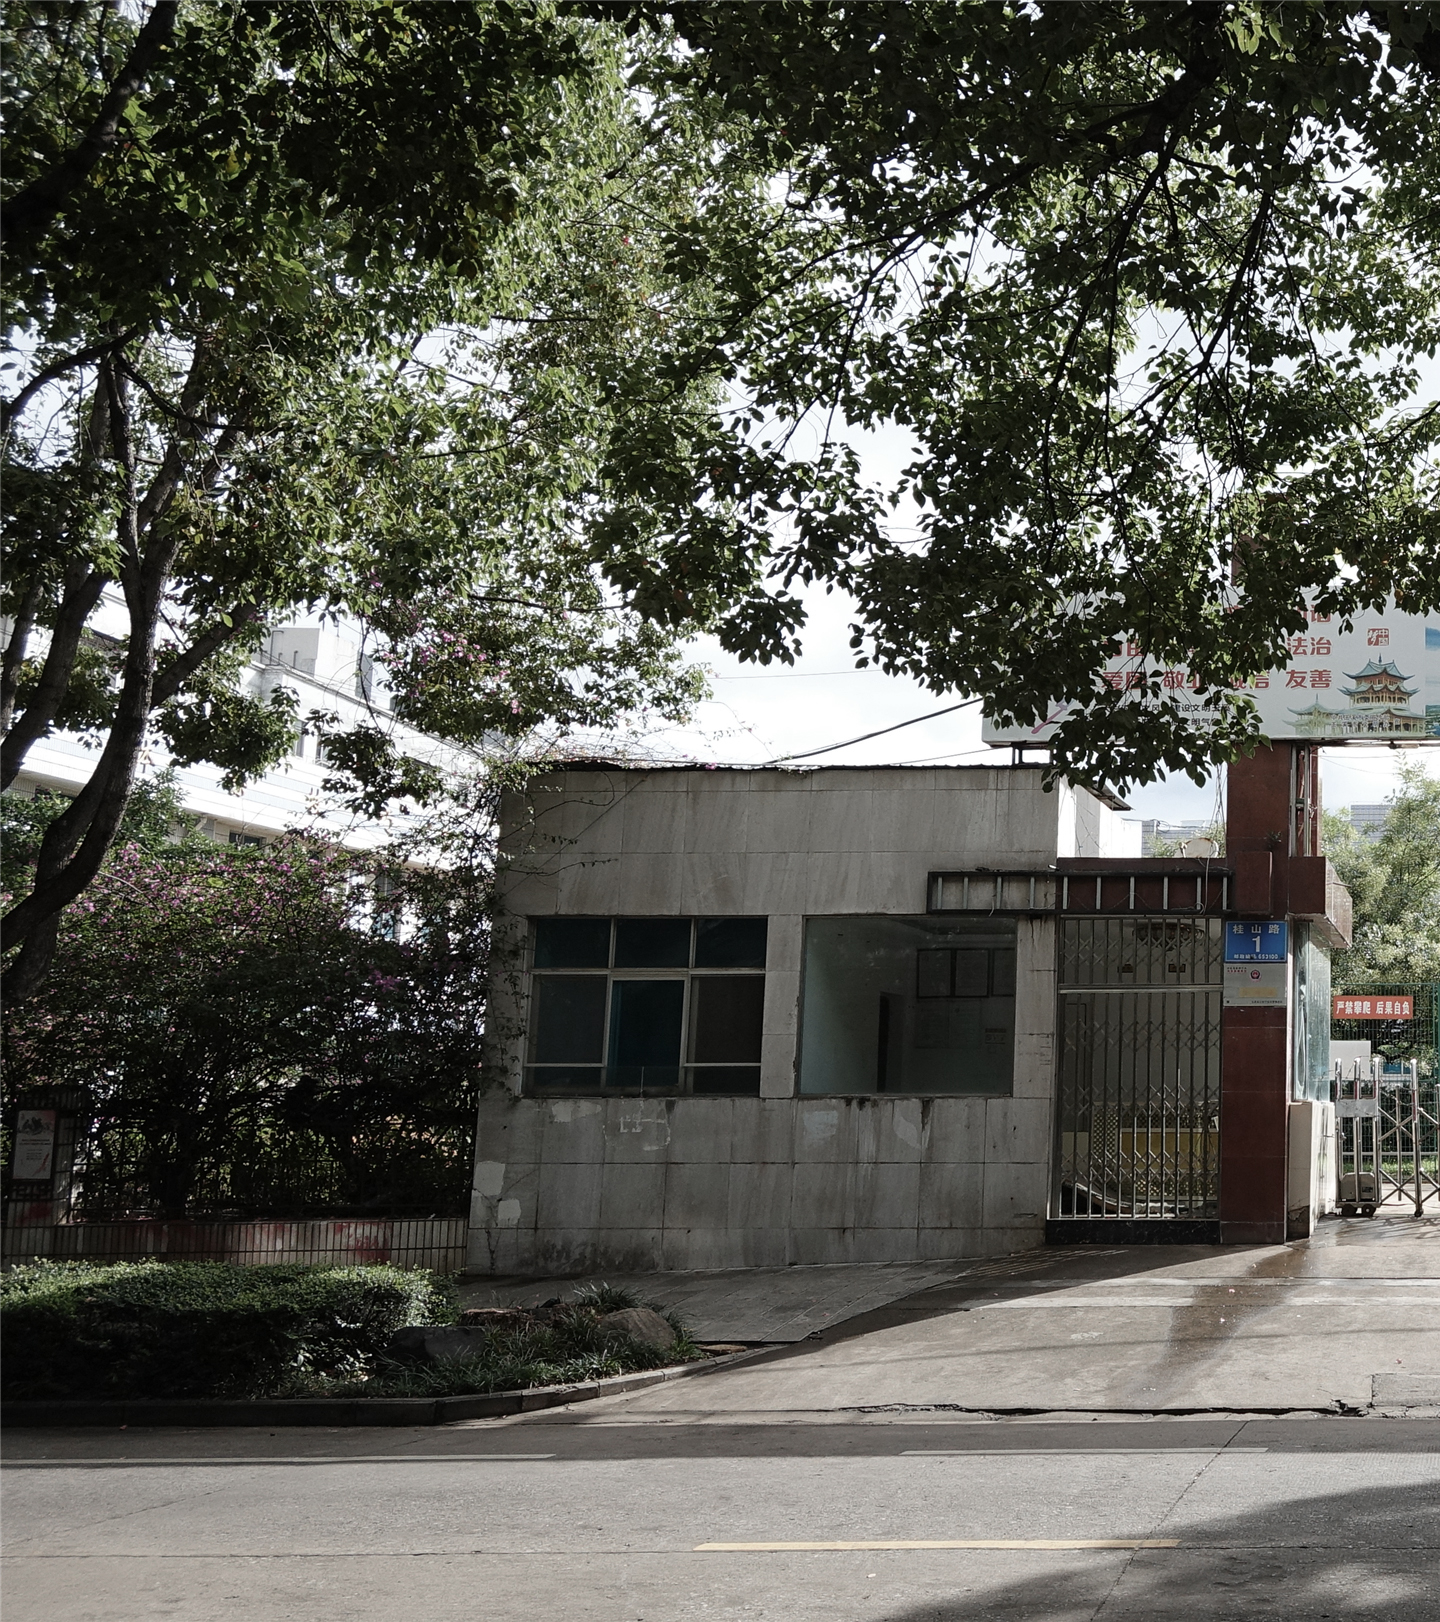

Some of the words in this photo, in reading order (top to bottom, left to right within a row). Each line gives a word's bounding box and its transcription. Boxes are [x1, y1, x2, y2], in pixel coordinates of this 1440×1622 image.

[1287, 637, 1332, 656] 法治
[1285, 669, 1332, 689] 友善
[1233, 924, 1280, 935] 桂山路
[1252, 935, 1261, 953] 1
[1336, 1001, 1371, 1015] 严禁攀爬
[1375, 1001, 1410, 1015] 后果自负
